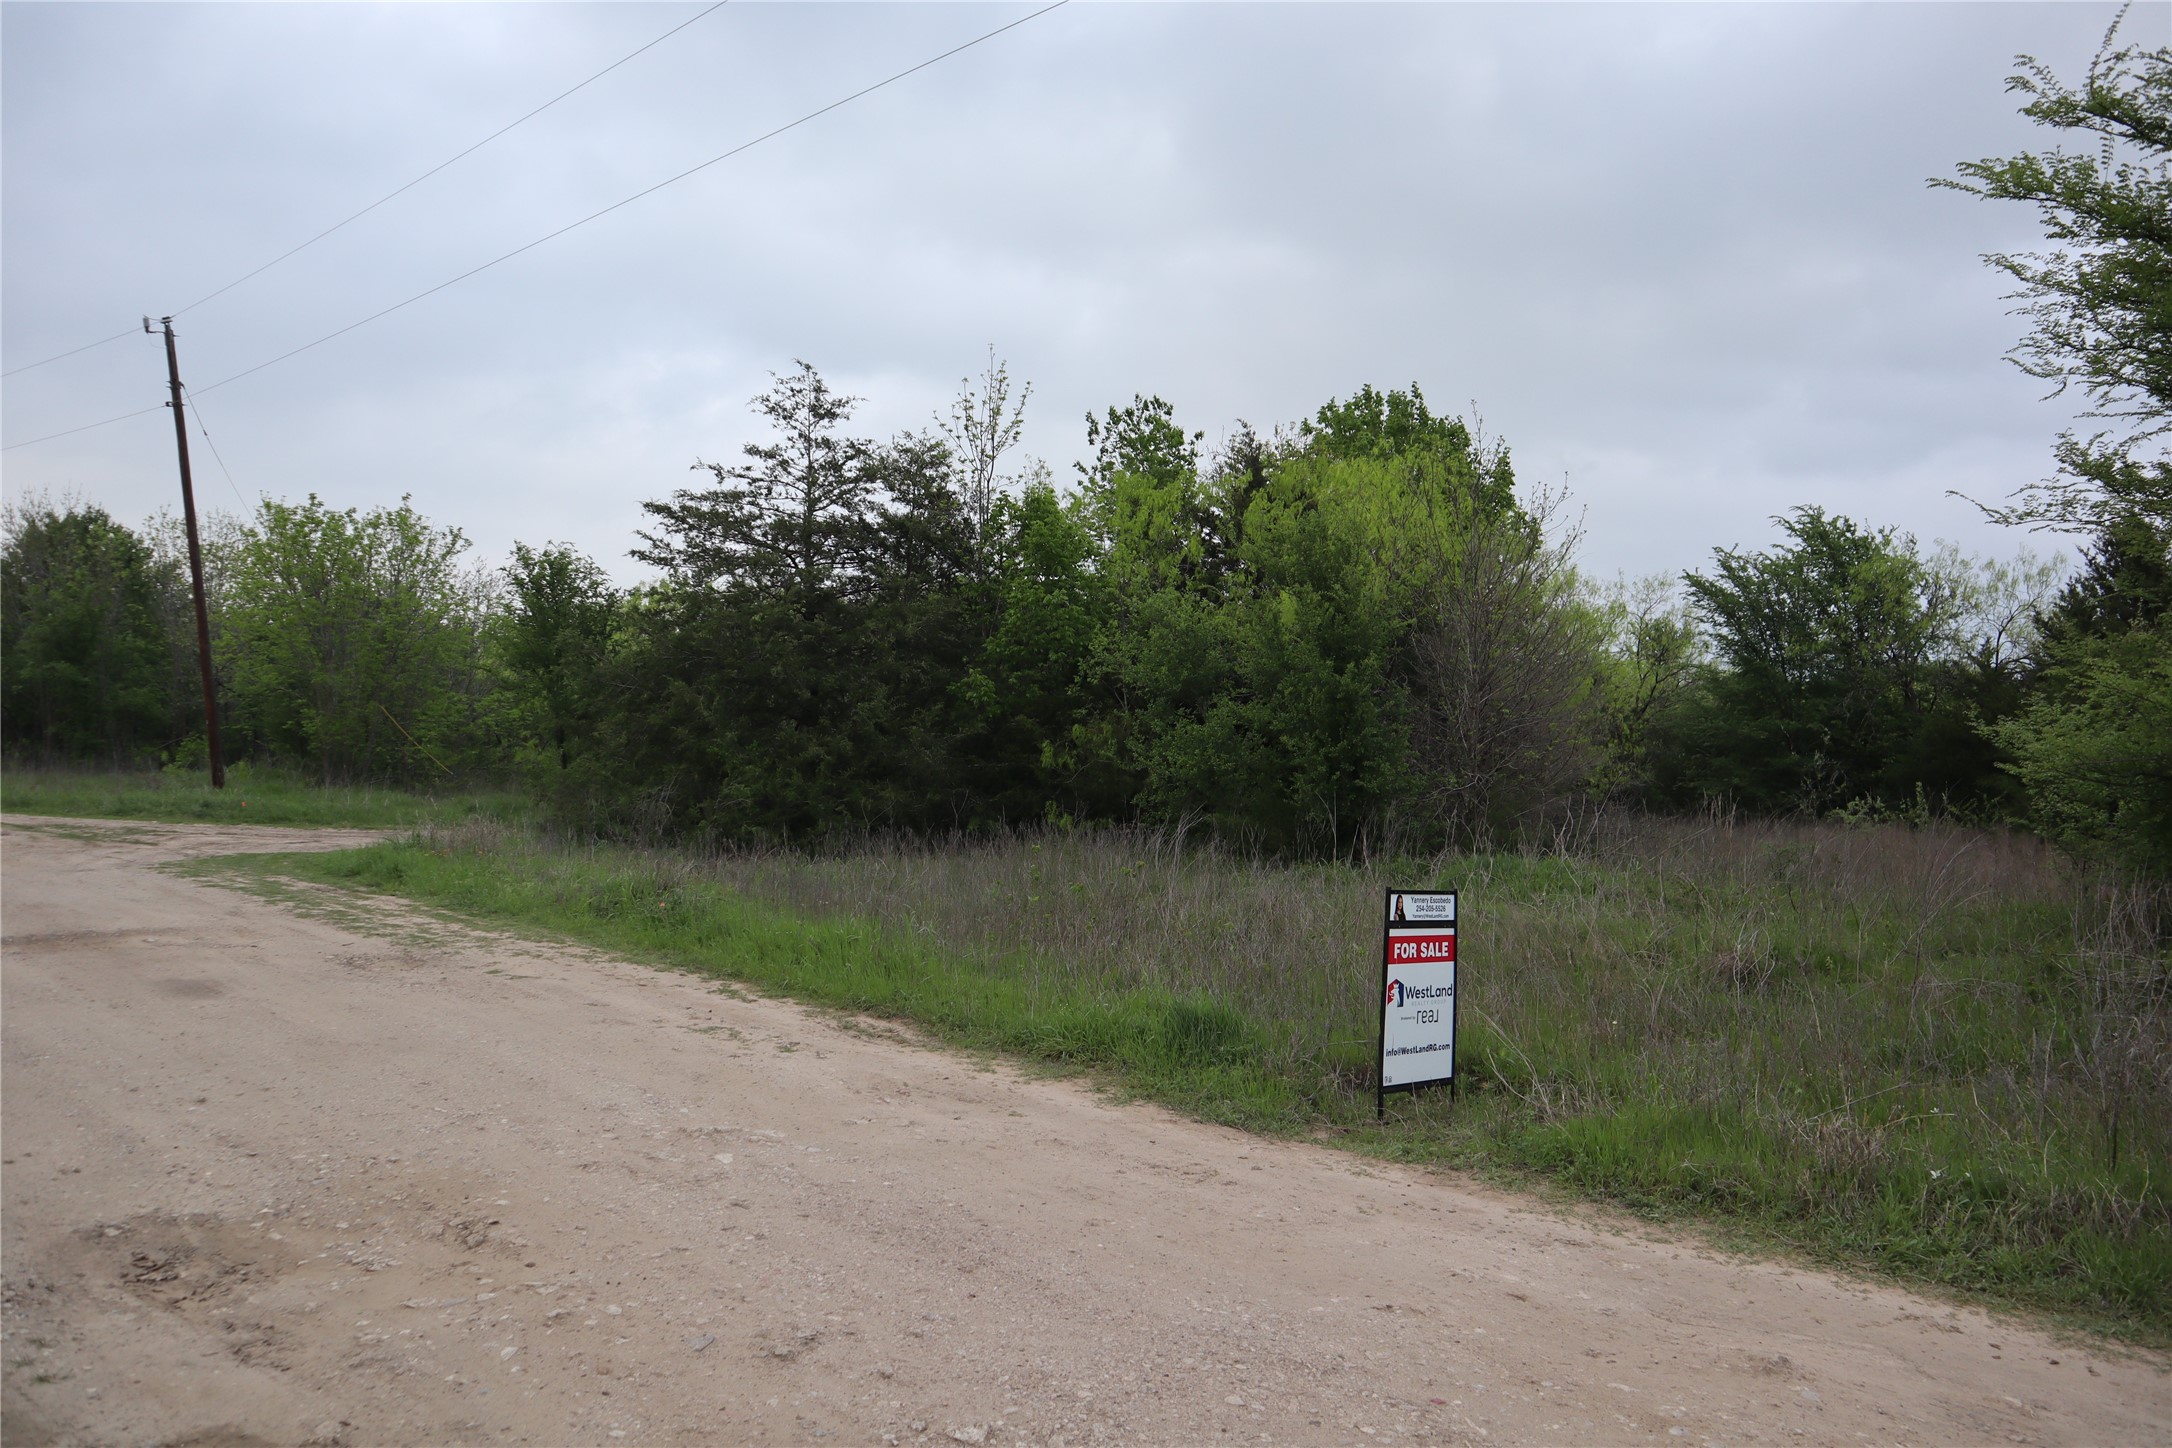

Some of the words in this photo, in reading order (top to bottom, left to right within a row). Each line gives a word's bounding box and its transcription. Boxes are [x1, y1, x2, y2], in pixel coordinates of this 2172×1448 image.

[1394, 943, 1417, 959] FOR
[1420, 942, 1449, 958] SALE
[1405, 984, 1453, 999] WestLand
[1416, 1009, 1439, 1024] real
[1386, 1044, 1450, 1057] info@WestLandRG.com
